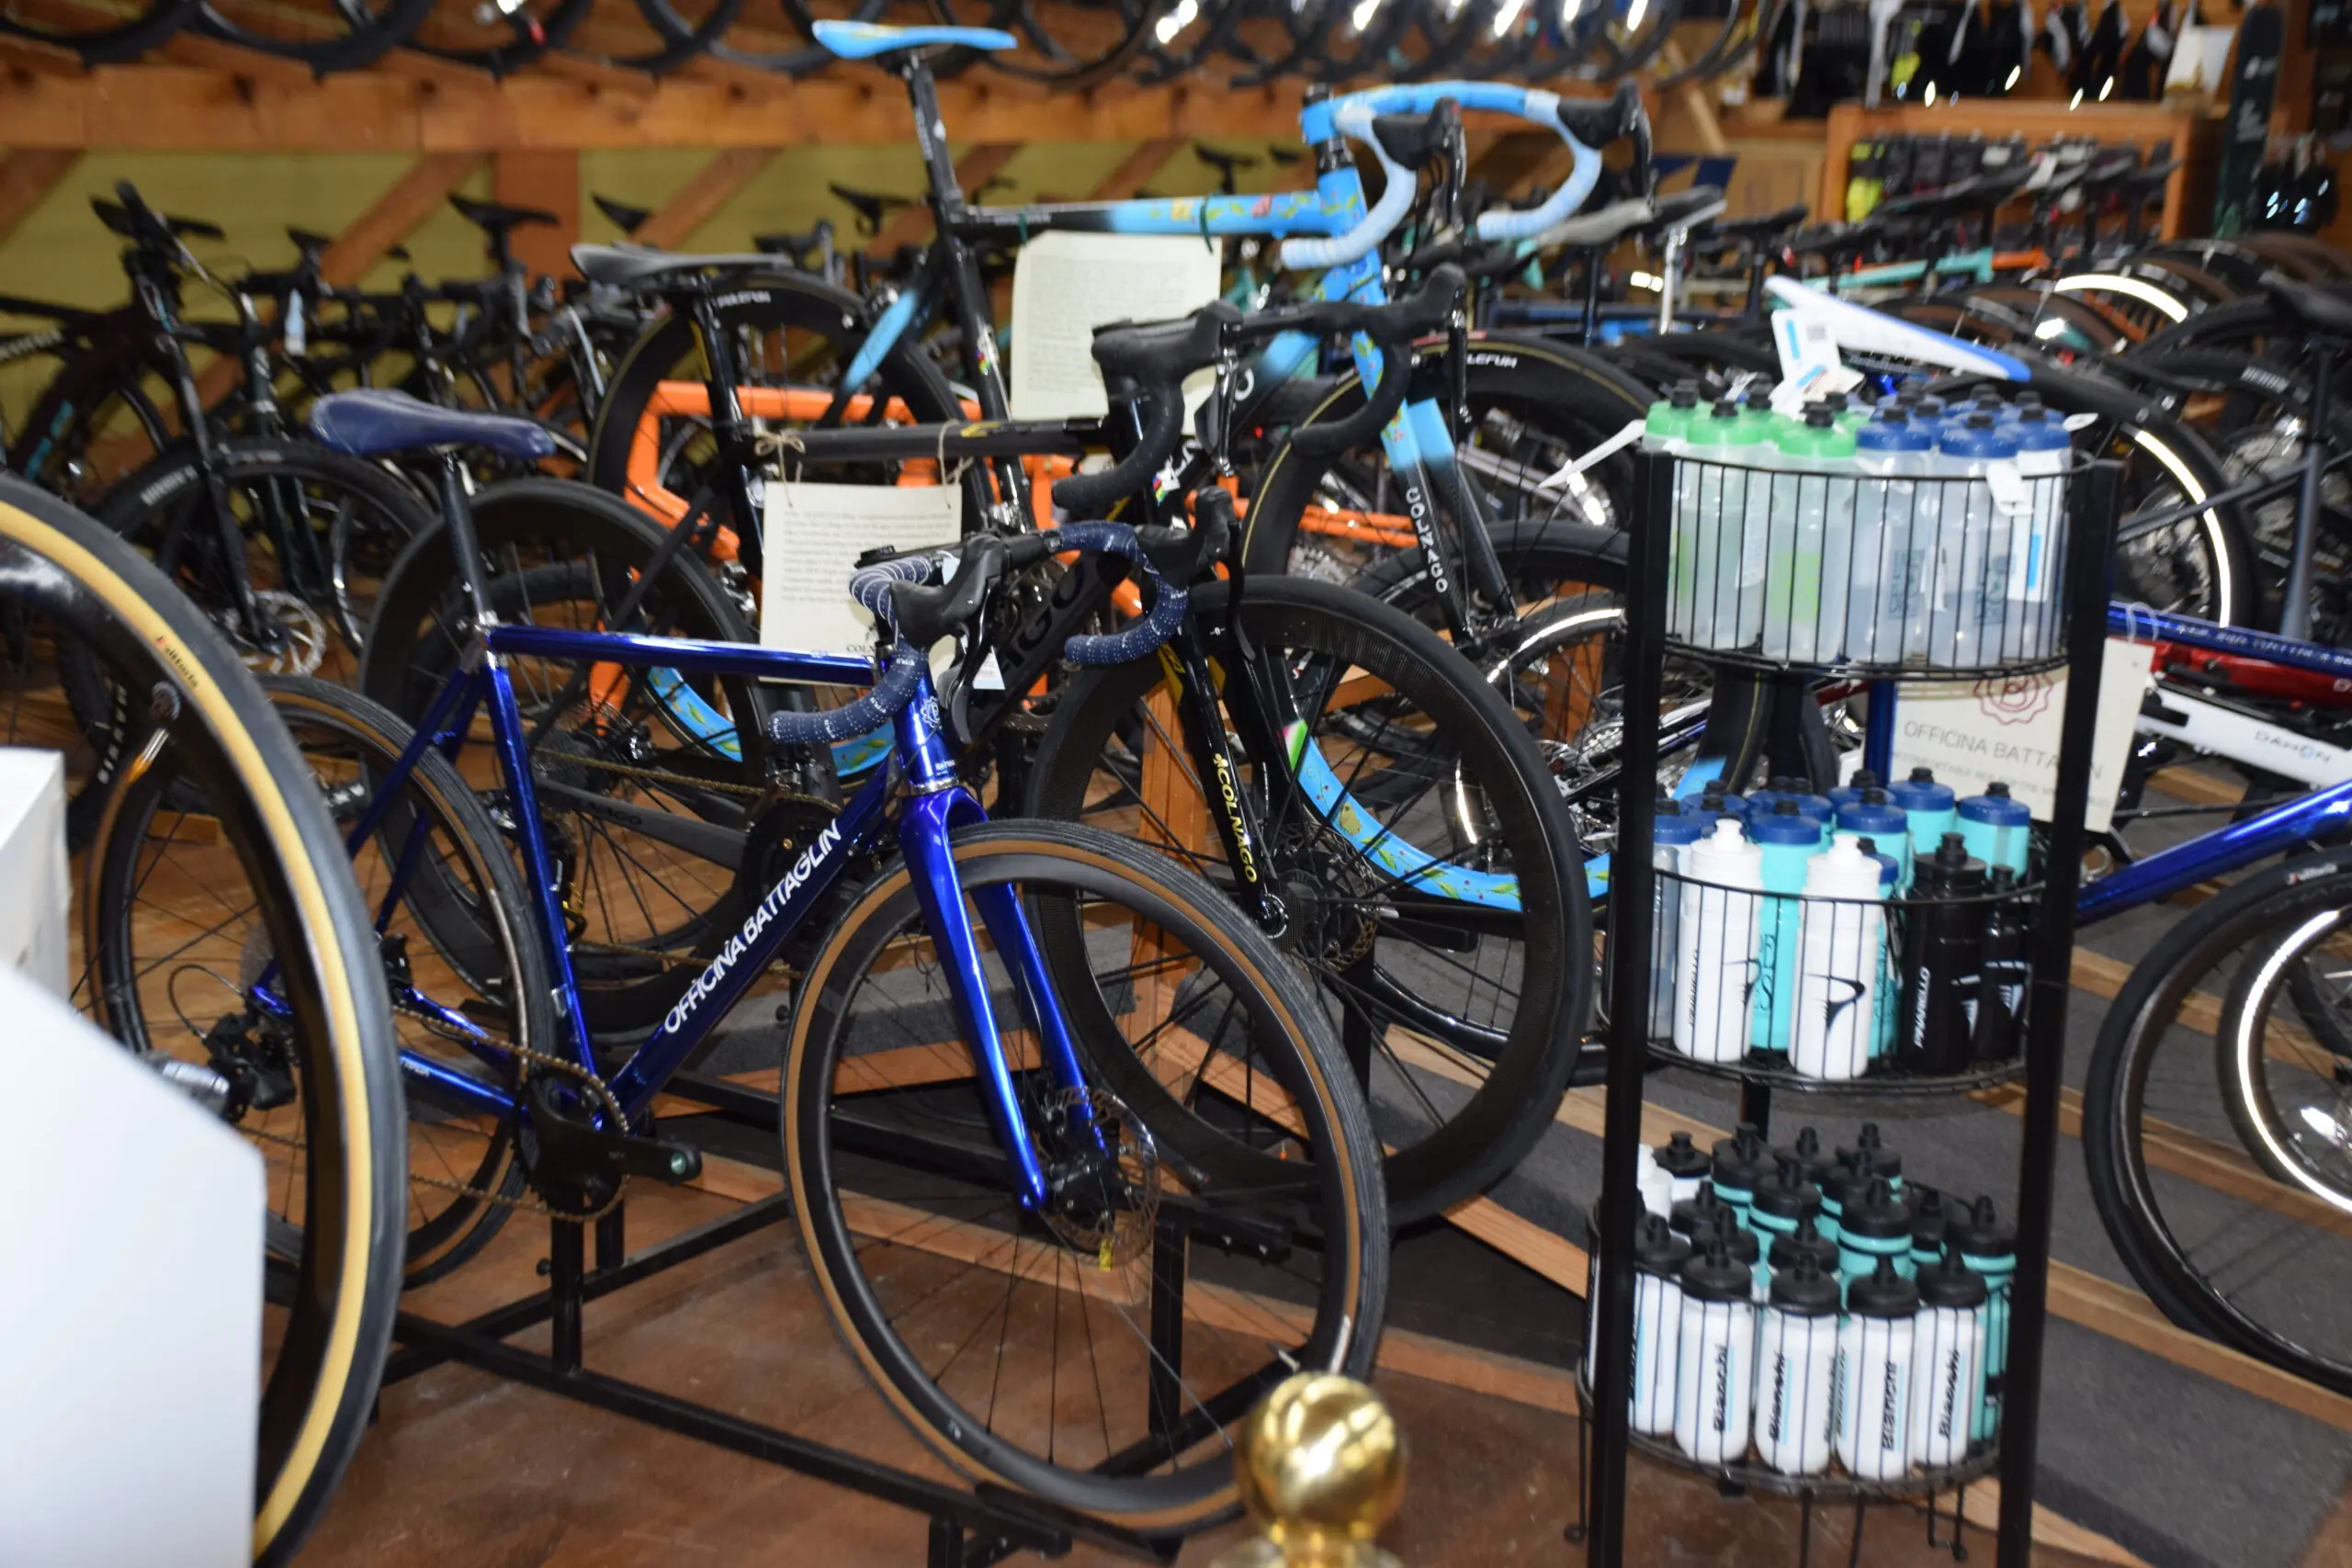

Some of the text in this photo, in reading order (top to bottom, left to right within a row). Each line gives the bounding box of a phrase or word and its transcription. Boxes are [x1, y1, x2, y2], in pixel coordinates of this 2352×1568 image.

[1405, 486, 1449, 593] COLNAGO
[846, 643, 876, 654] COLN
[1904, 720, 2104, 780] OFFICINA BATTAN
[2255, 730, 2332, 764] DAHON
[1216, 766, 1258, 883] COLNAGO
[664, 818, 842, 1034] OFFICINA BATTAGLIN
[1913, 965, 1930, 1050] PINARELLO
